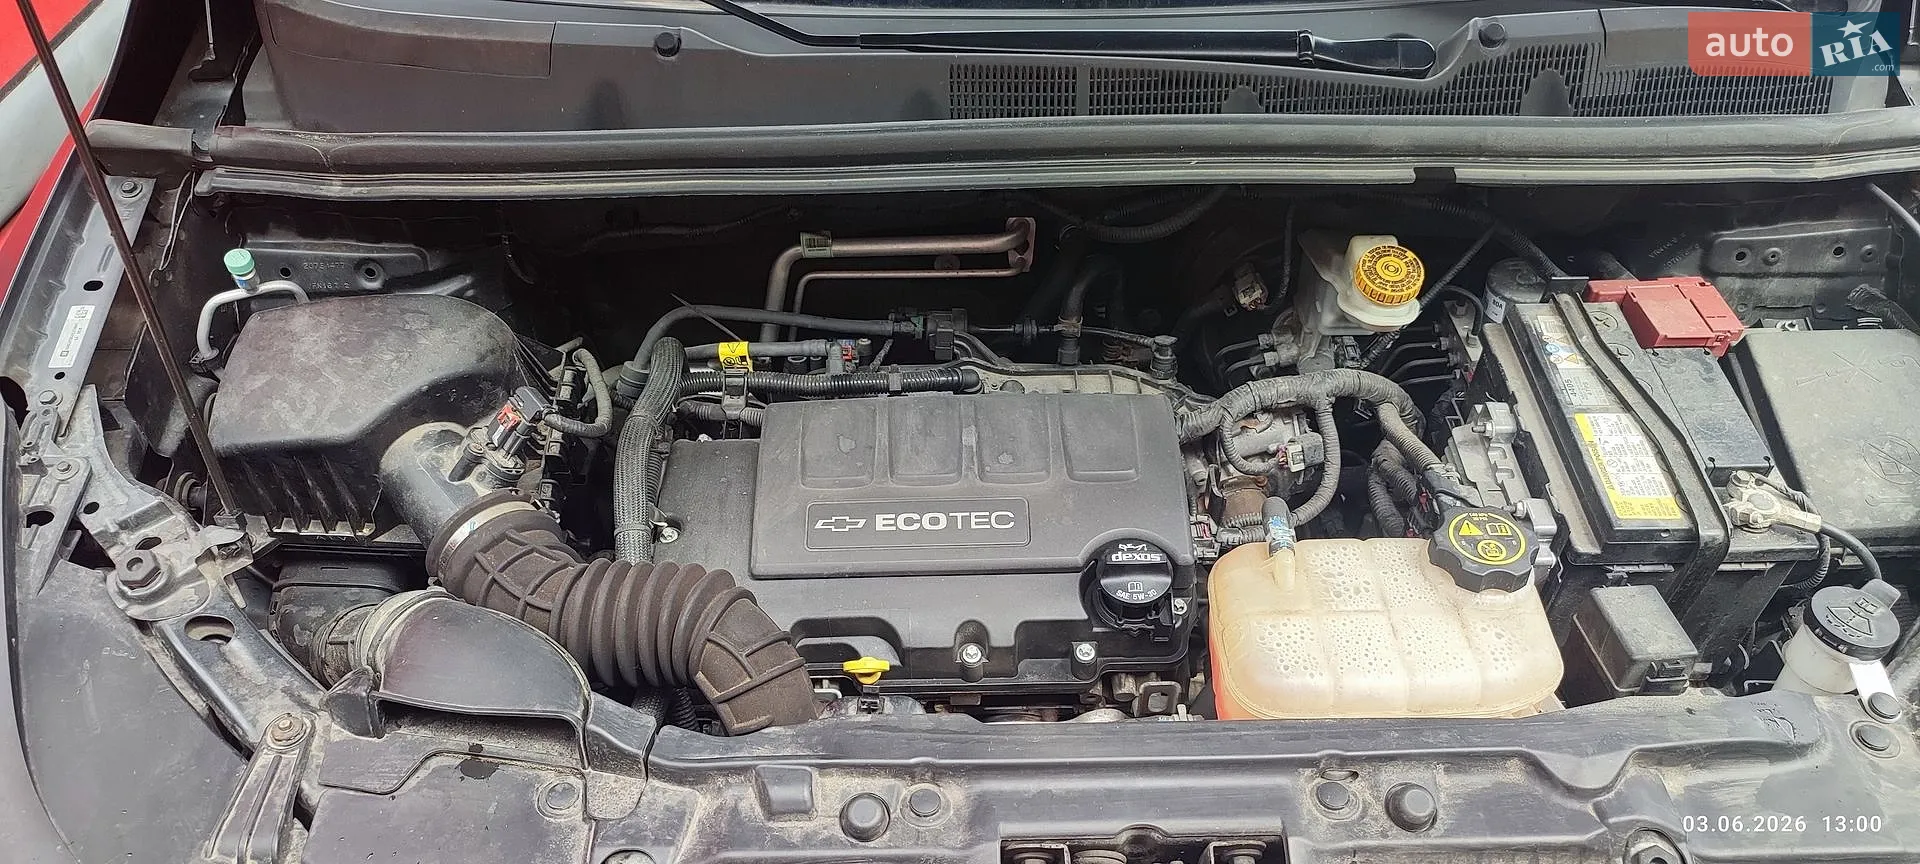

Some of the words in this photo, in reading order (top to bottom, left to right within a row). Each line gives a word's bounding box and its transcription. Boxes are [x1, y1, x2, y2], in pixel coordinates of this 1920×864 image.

[875, 511, 1015, 531] ECOTEC
[1111, 551, 1163, 562] dexos
[1115, 589, 1130, 600] SAE
[1132, 588, 1158, 601] 5W-30
